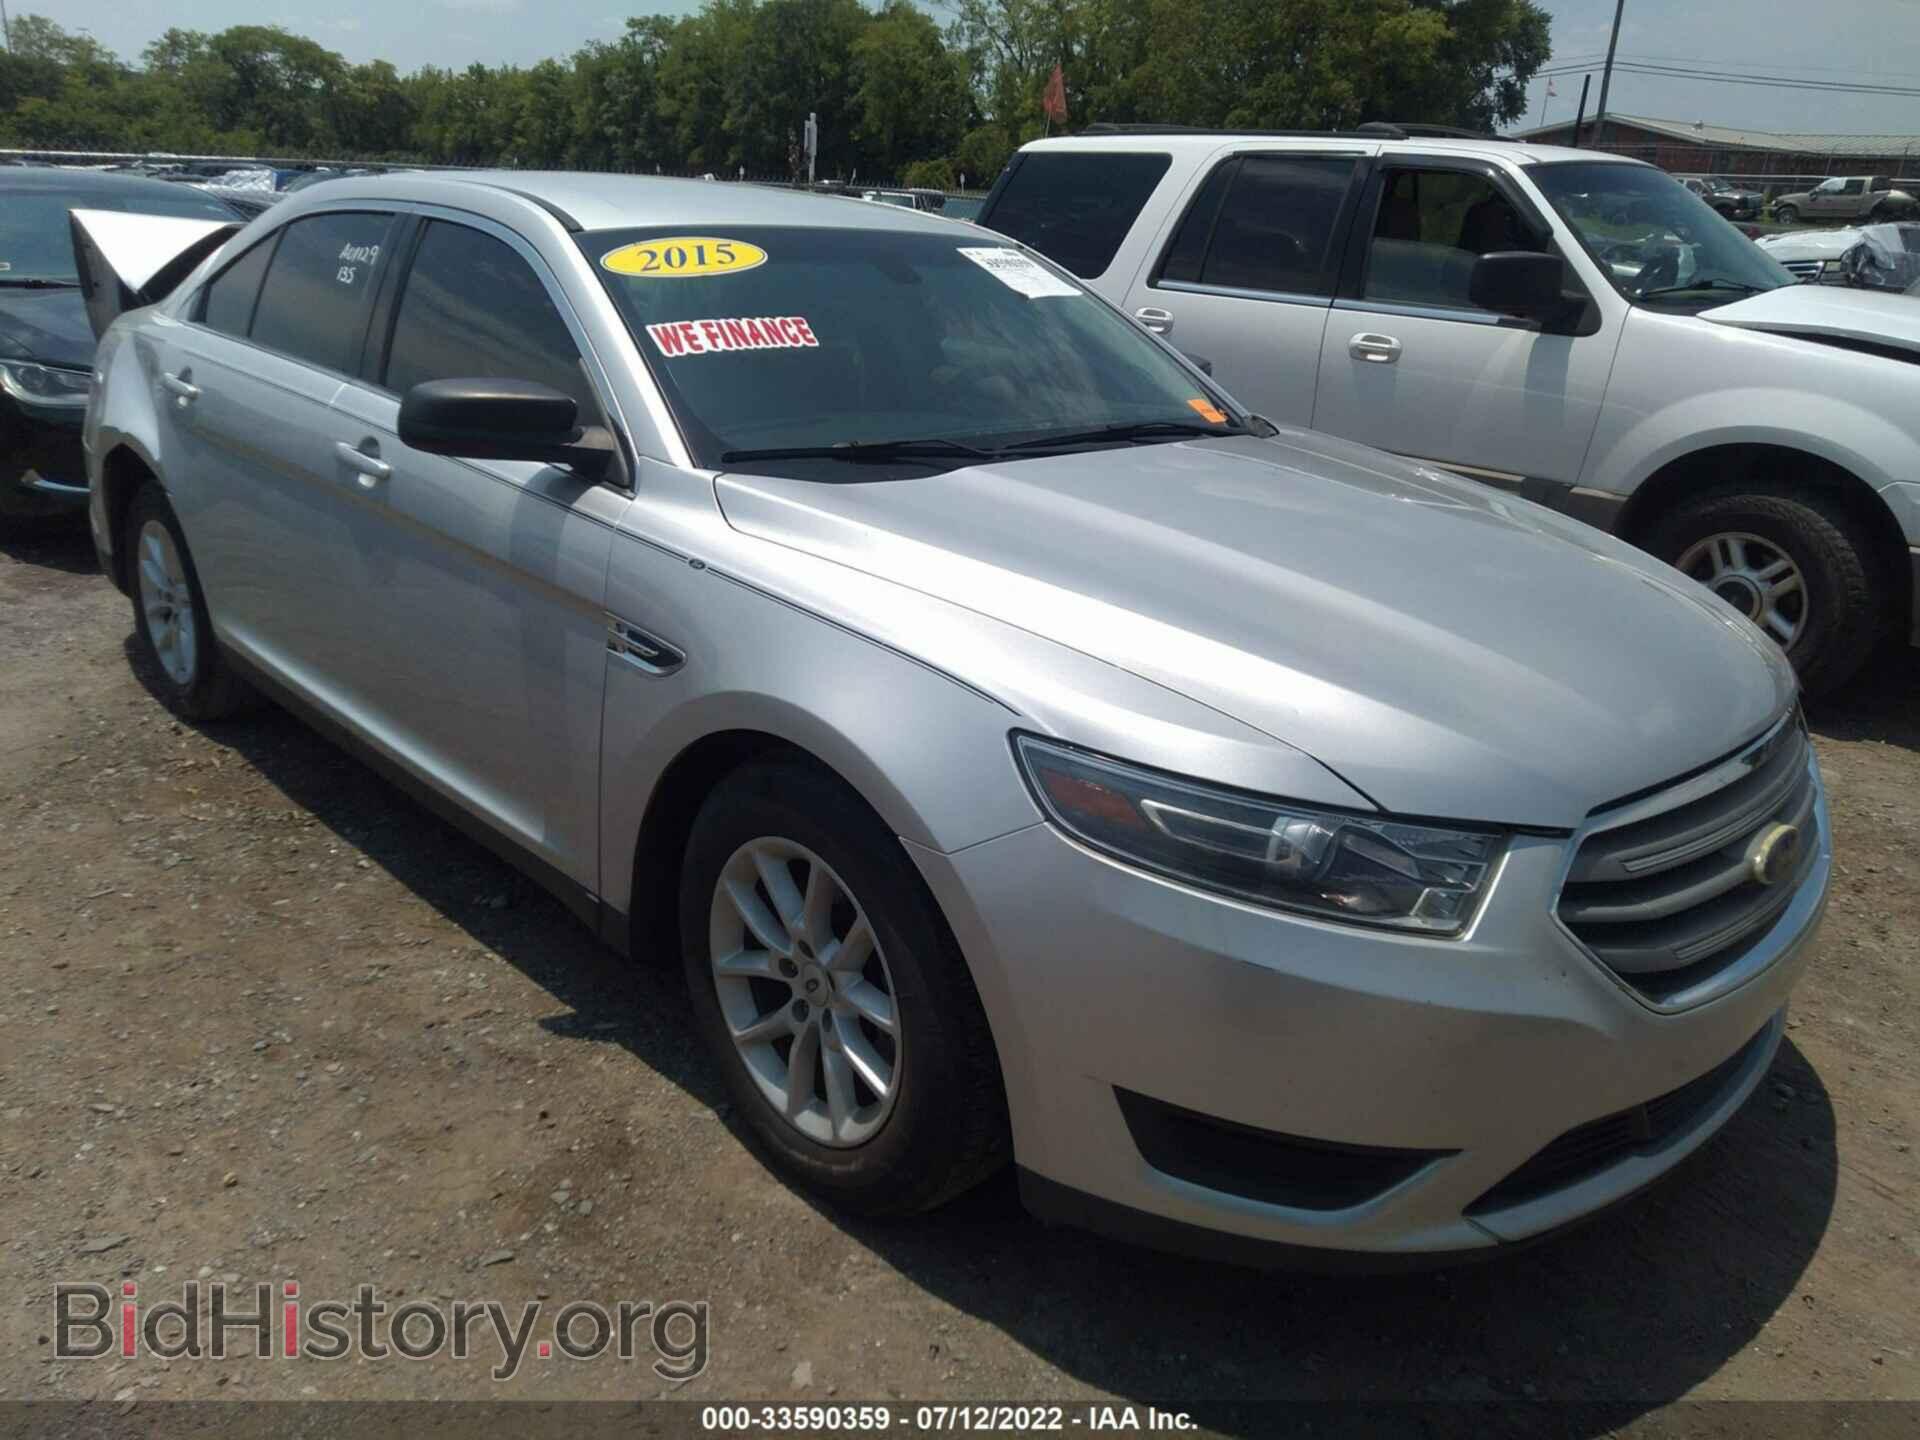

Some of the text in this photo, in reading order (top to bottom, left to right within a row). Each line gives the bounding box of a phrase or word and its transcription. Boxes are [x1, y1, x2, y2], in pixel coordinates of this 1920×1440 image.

[637, 243, 736, 271] 2015
[651, 318, 817, 355] WE FINANCE
